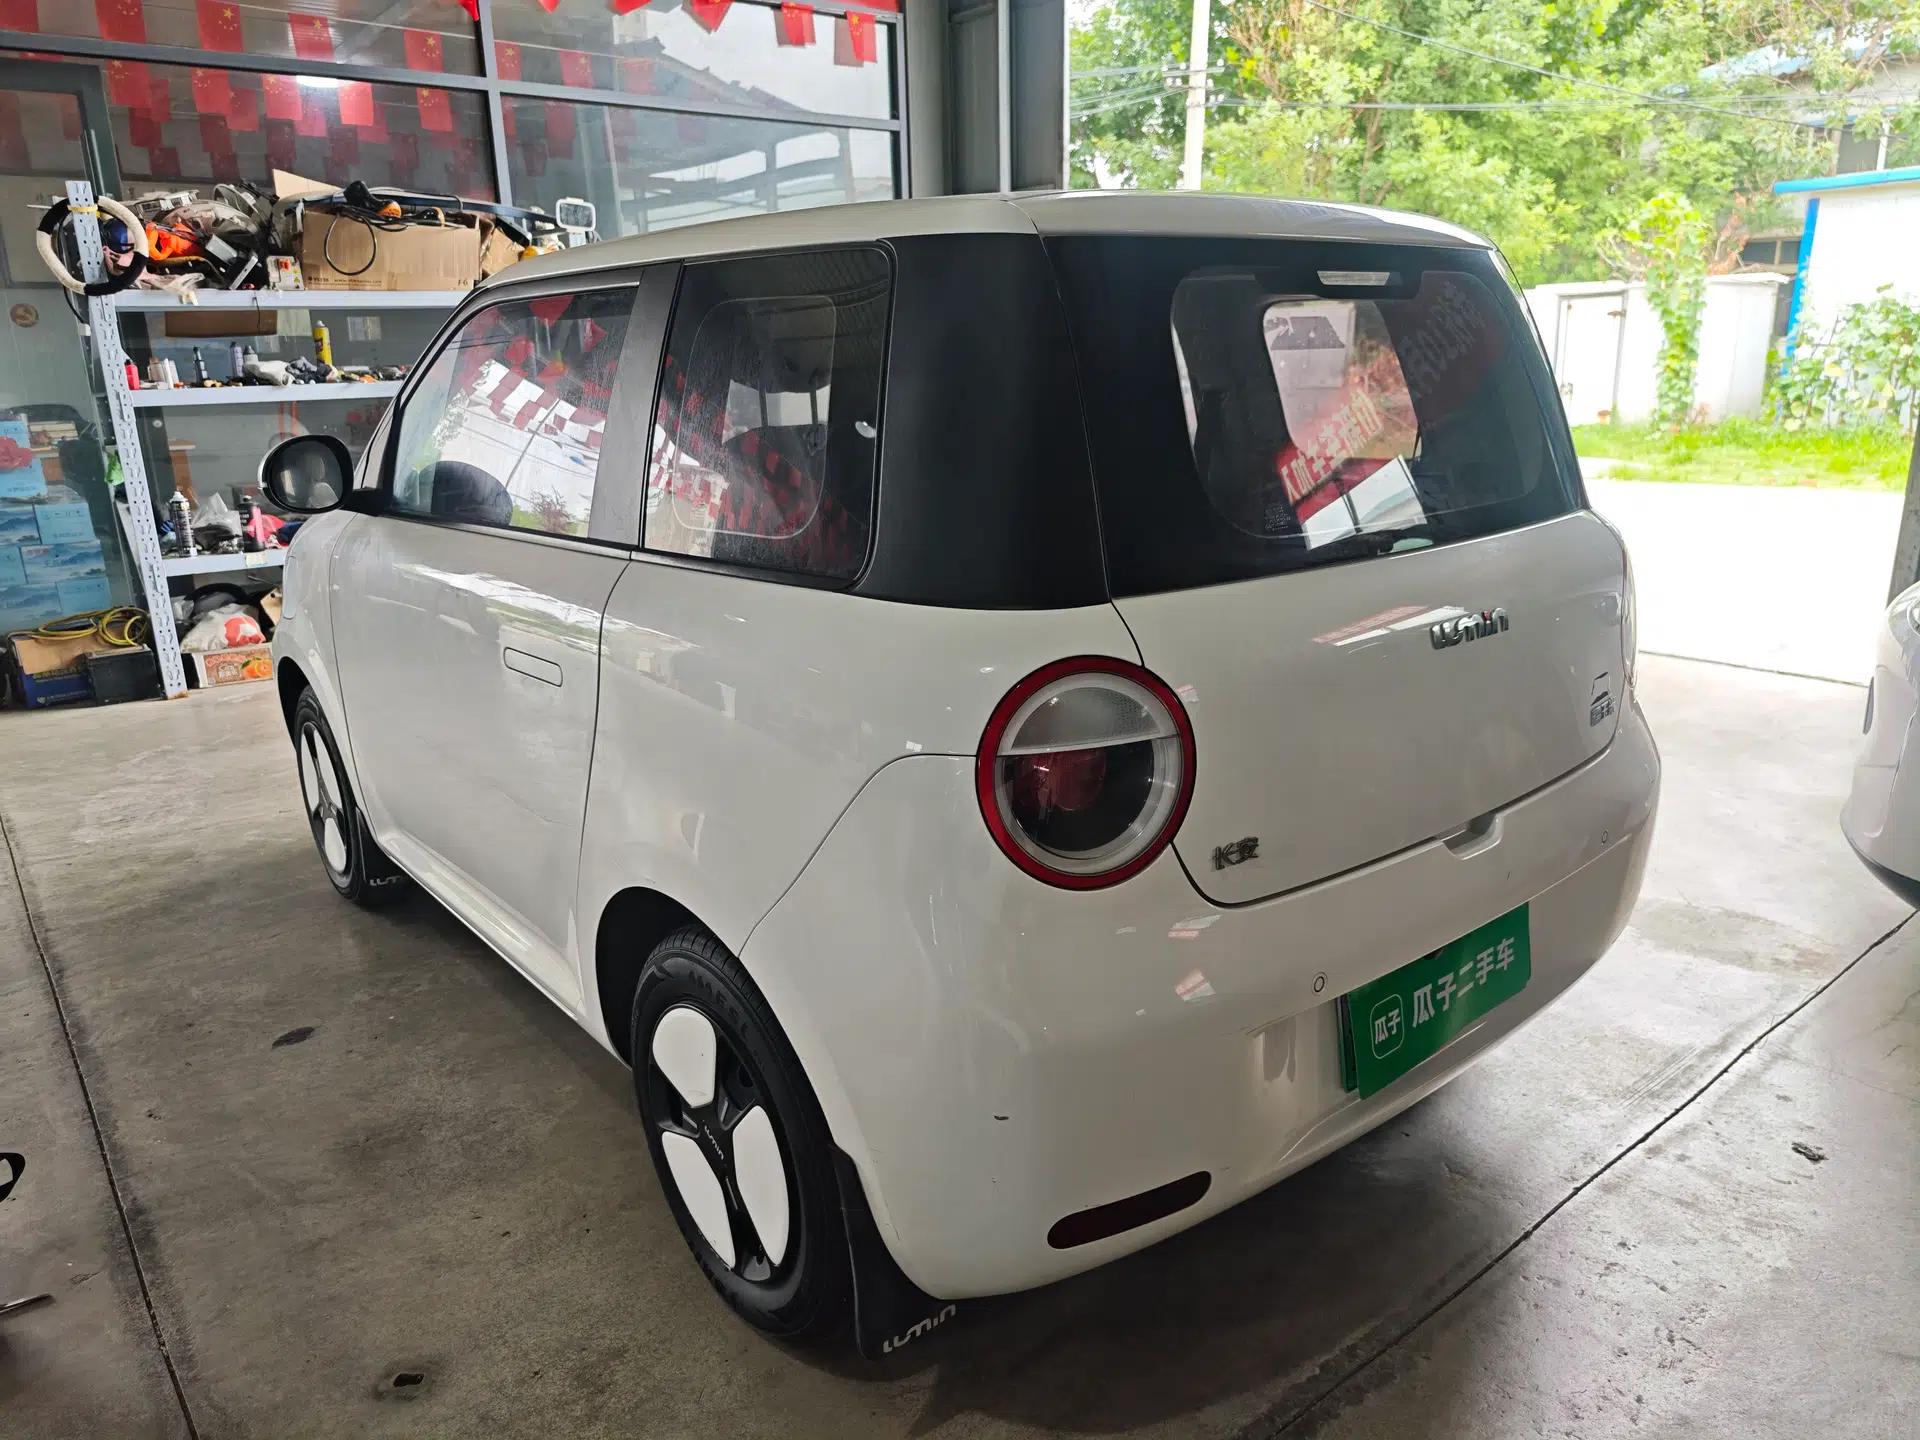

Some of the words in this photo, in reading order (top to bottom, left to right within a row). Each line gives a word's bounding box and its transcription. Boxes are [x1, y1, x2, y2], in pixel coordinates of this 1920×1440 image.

[1412, 937, 1515, 1028] 瓜子二手车
[1374, 1007, 1401, 1044] 瓜子
